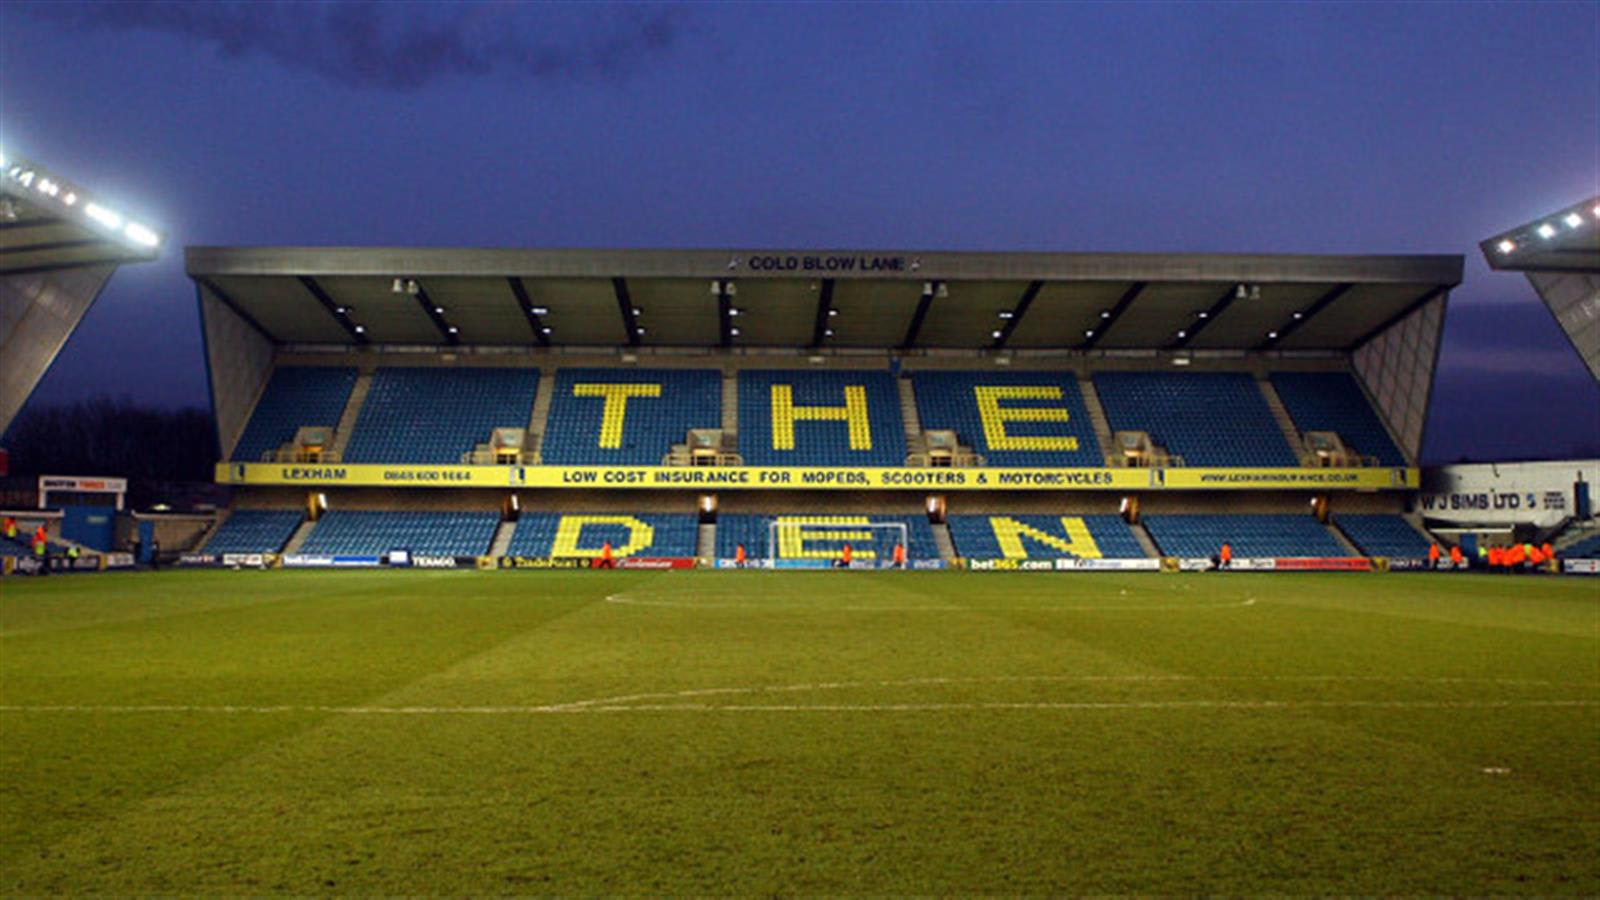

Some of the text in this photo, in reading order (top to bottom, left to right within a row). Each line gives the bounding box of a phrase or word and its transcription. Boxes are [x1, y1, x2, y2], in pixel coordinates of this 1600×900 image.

[749, 256, 905, 271] COLD BLOW LANE
[573, 383, 1078, 451] THE
[282, 467, 347, 480] LEXHAM
[563, 470, 1113, 486] LOW COST INSURANCE FOR MOPEDS, SCOOTERS & MOTORCYCLES
[1421, 495, 1435, 510] W
[1438, 494, 1447, 509] J
[1451, 493, 1489, 509] SIMS
[1493, 493, 1520, 509] LTD
[551, 515, 1102, 558] DEN
[970, 558, 1053, 570] bet365.com
